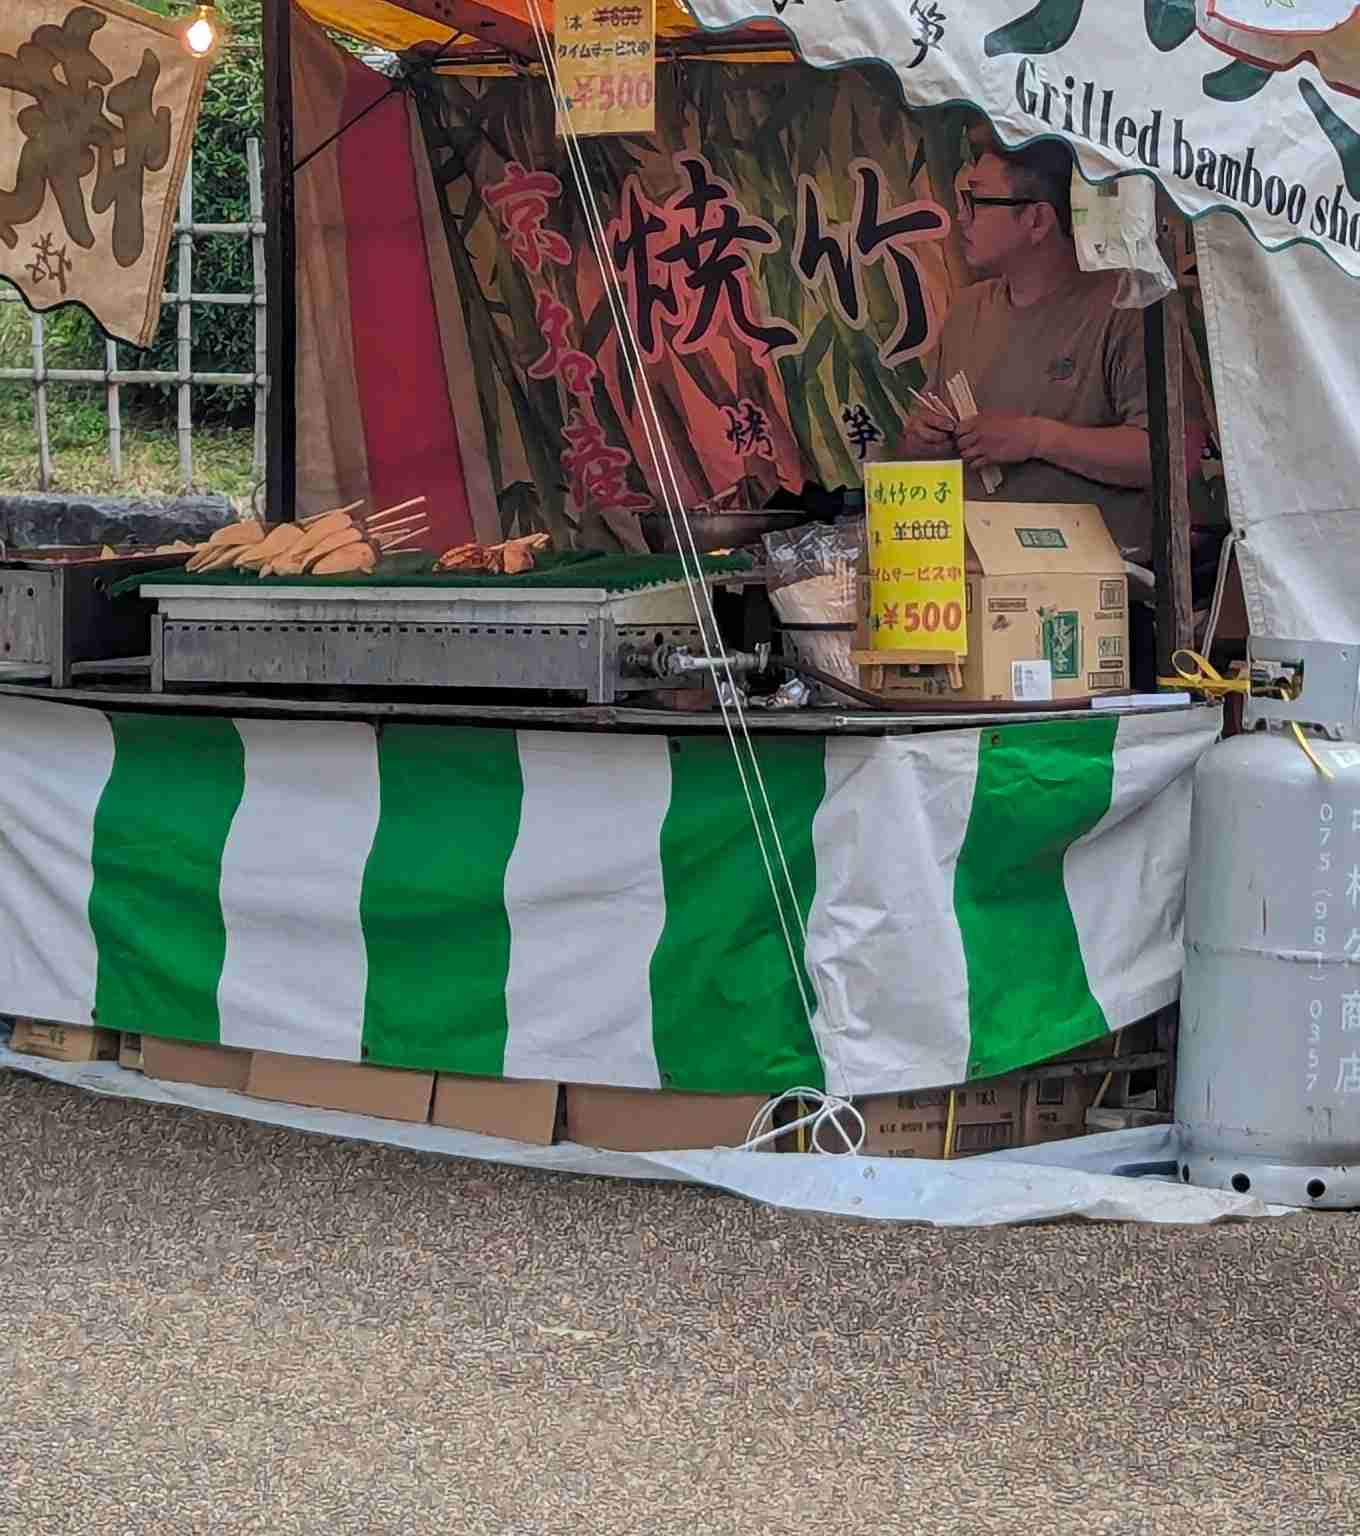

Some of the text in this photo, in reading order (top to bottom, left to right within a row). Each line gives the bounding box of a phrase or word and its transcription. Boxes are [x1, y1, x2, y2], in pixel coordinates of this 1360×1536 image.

[575, 73, 653, 112] ¥500
[1015, 56, 1163, 169] Grilled
[1172, 118, 1307, 226] bamboo
[883, 601, 962, 633] ¥500
